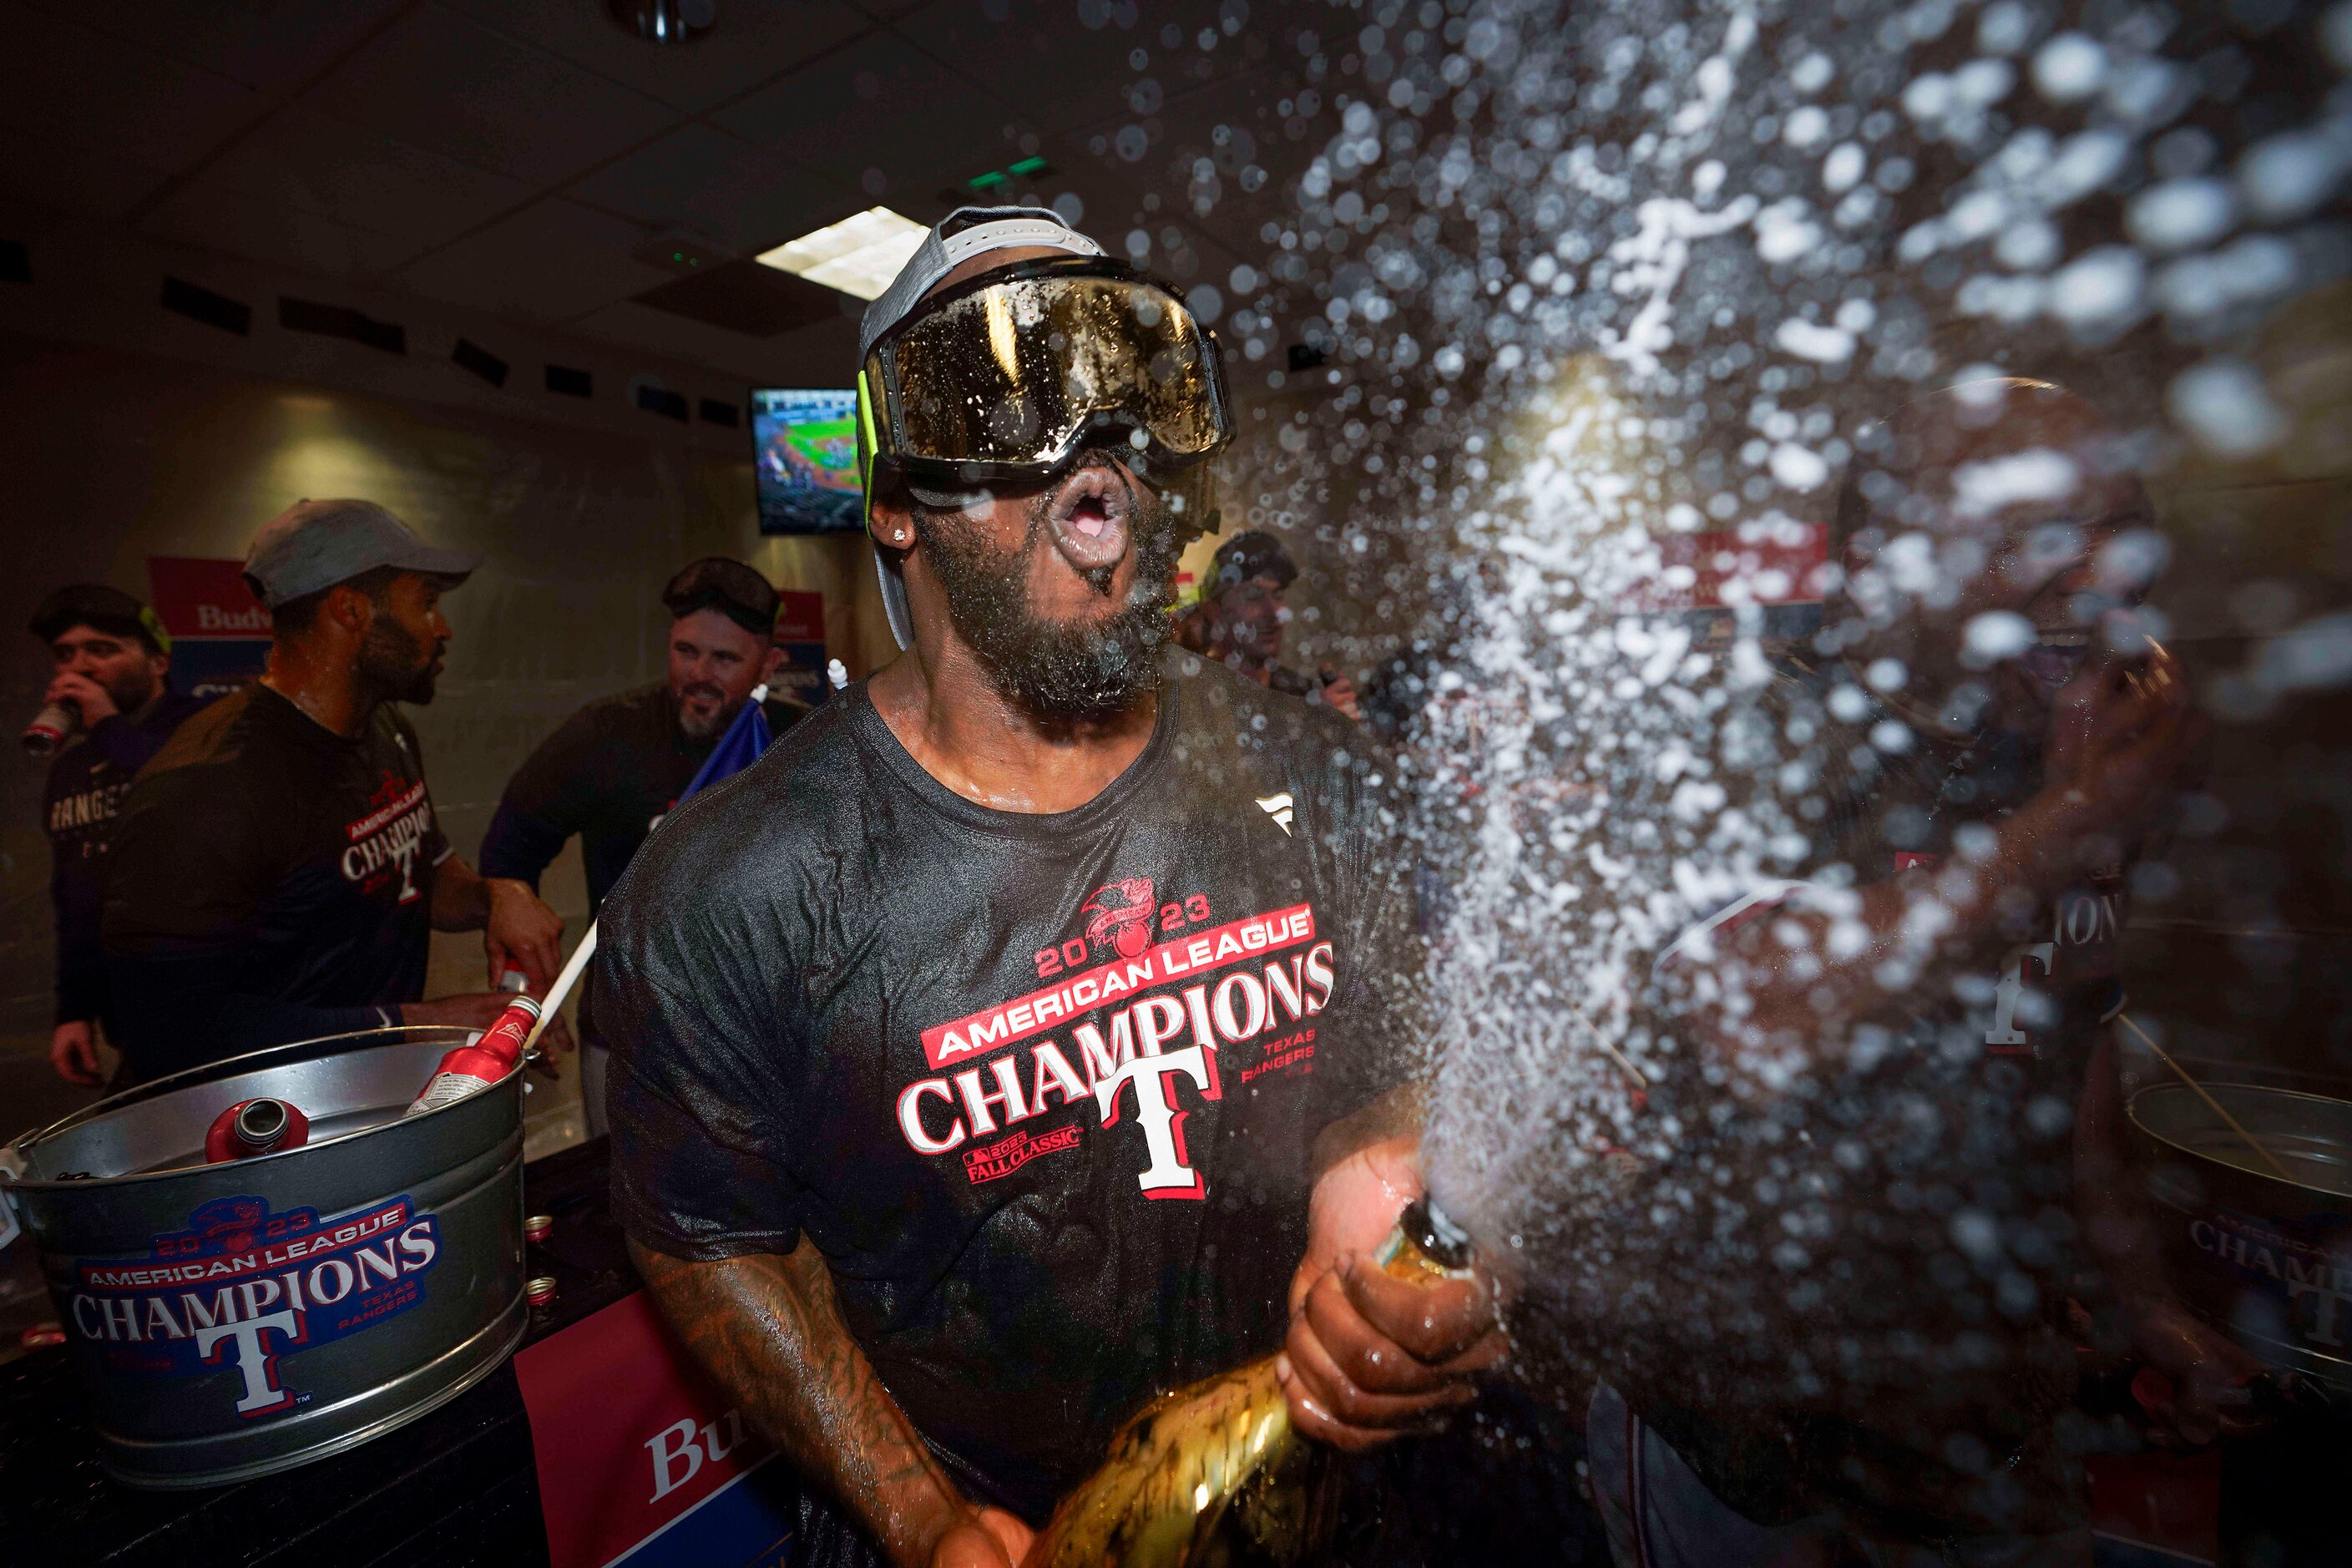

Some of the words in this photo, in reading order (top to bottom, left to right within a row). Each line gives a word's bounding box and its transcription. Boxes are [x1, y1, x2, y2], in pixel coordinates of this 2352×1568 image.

[1034, 937, 1088, 979] 20
[1160, 892, 1211, 931] 23
[937, 960, 1154, 1061] AMERICAN
[1161, 908, 1313, 974] LEAGUE
[896, 941, 1335, 1156] CHAMPIONS
[1241, 1045, 1316, 1084] RANGERS
[1263, 1029, 1316, 1056] TEXAS
[990, 1133, 1028, 1158] 2023
[1095, 1044, 1223, 1200] T
[967, 1157, 1011, 1182] FALL
[1009, 1129, 1080, 1166] CLASSIC
[89, 1253, 256, 1287] AMERICAN
[266, 1209, 402, 1263] LEAGUE
[155, 1237, 200, 1257] 20
[266, 1212, 311, 1237] 23
[73, 1219, 438, 1343] CHAMPIONS
[337, 1290, 417, 1330] RANGERS
[361, 1280, 415, 1309] TEXAS
[195, 1308, 311, 1420] T
